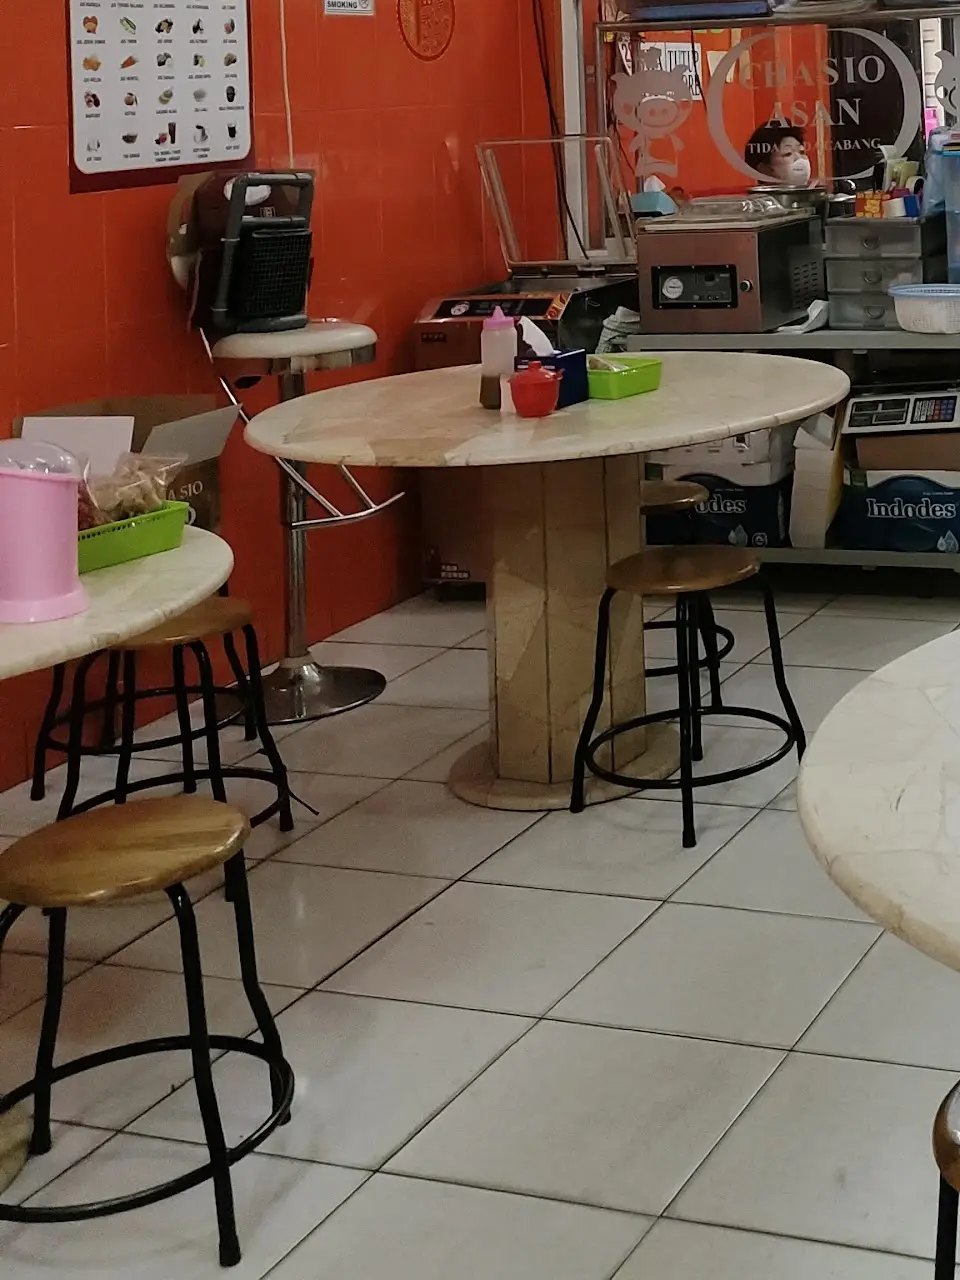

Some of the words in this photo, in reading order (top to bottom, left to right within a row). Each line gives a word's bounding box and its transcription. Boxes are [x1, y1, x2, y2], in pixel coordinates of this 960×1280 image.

[326, 0, 358, 9] SMOKING
[740, 54, 886, 90] CHASIO
[763, 97, 862, 130] ASAN
[748, 142, 785, 154] TIDA
[865, 497, 957, 520] Indodes
